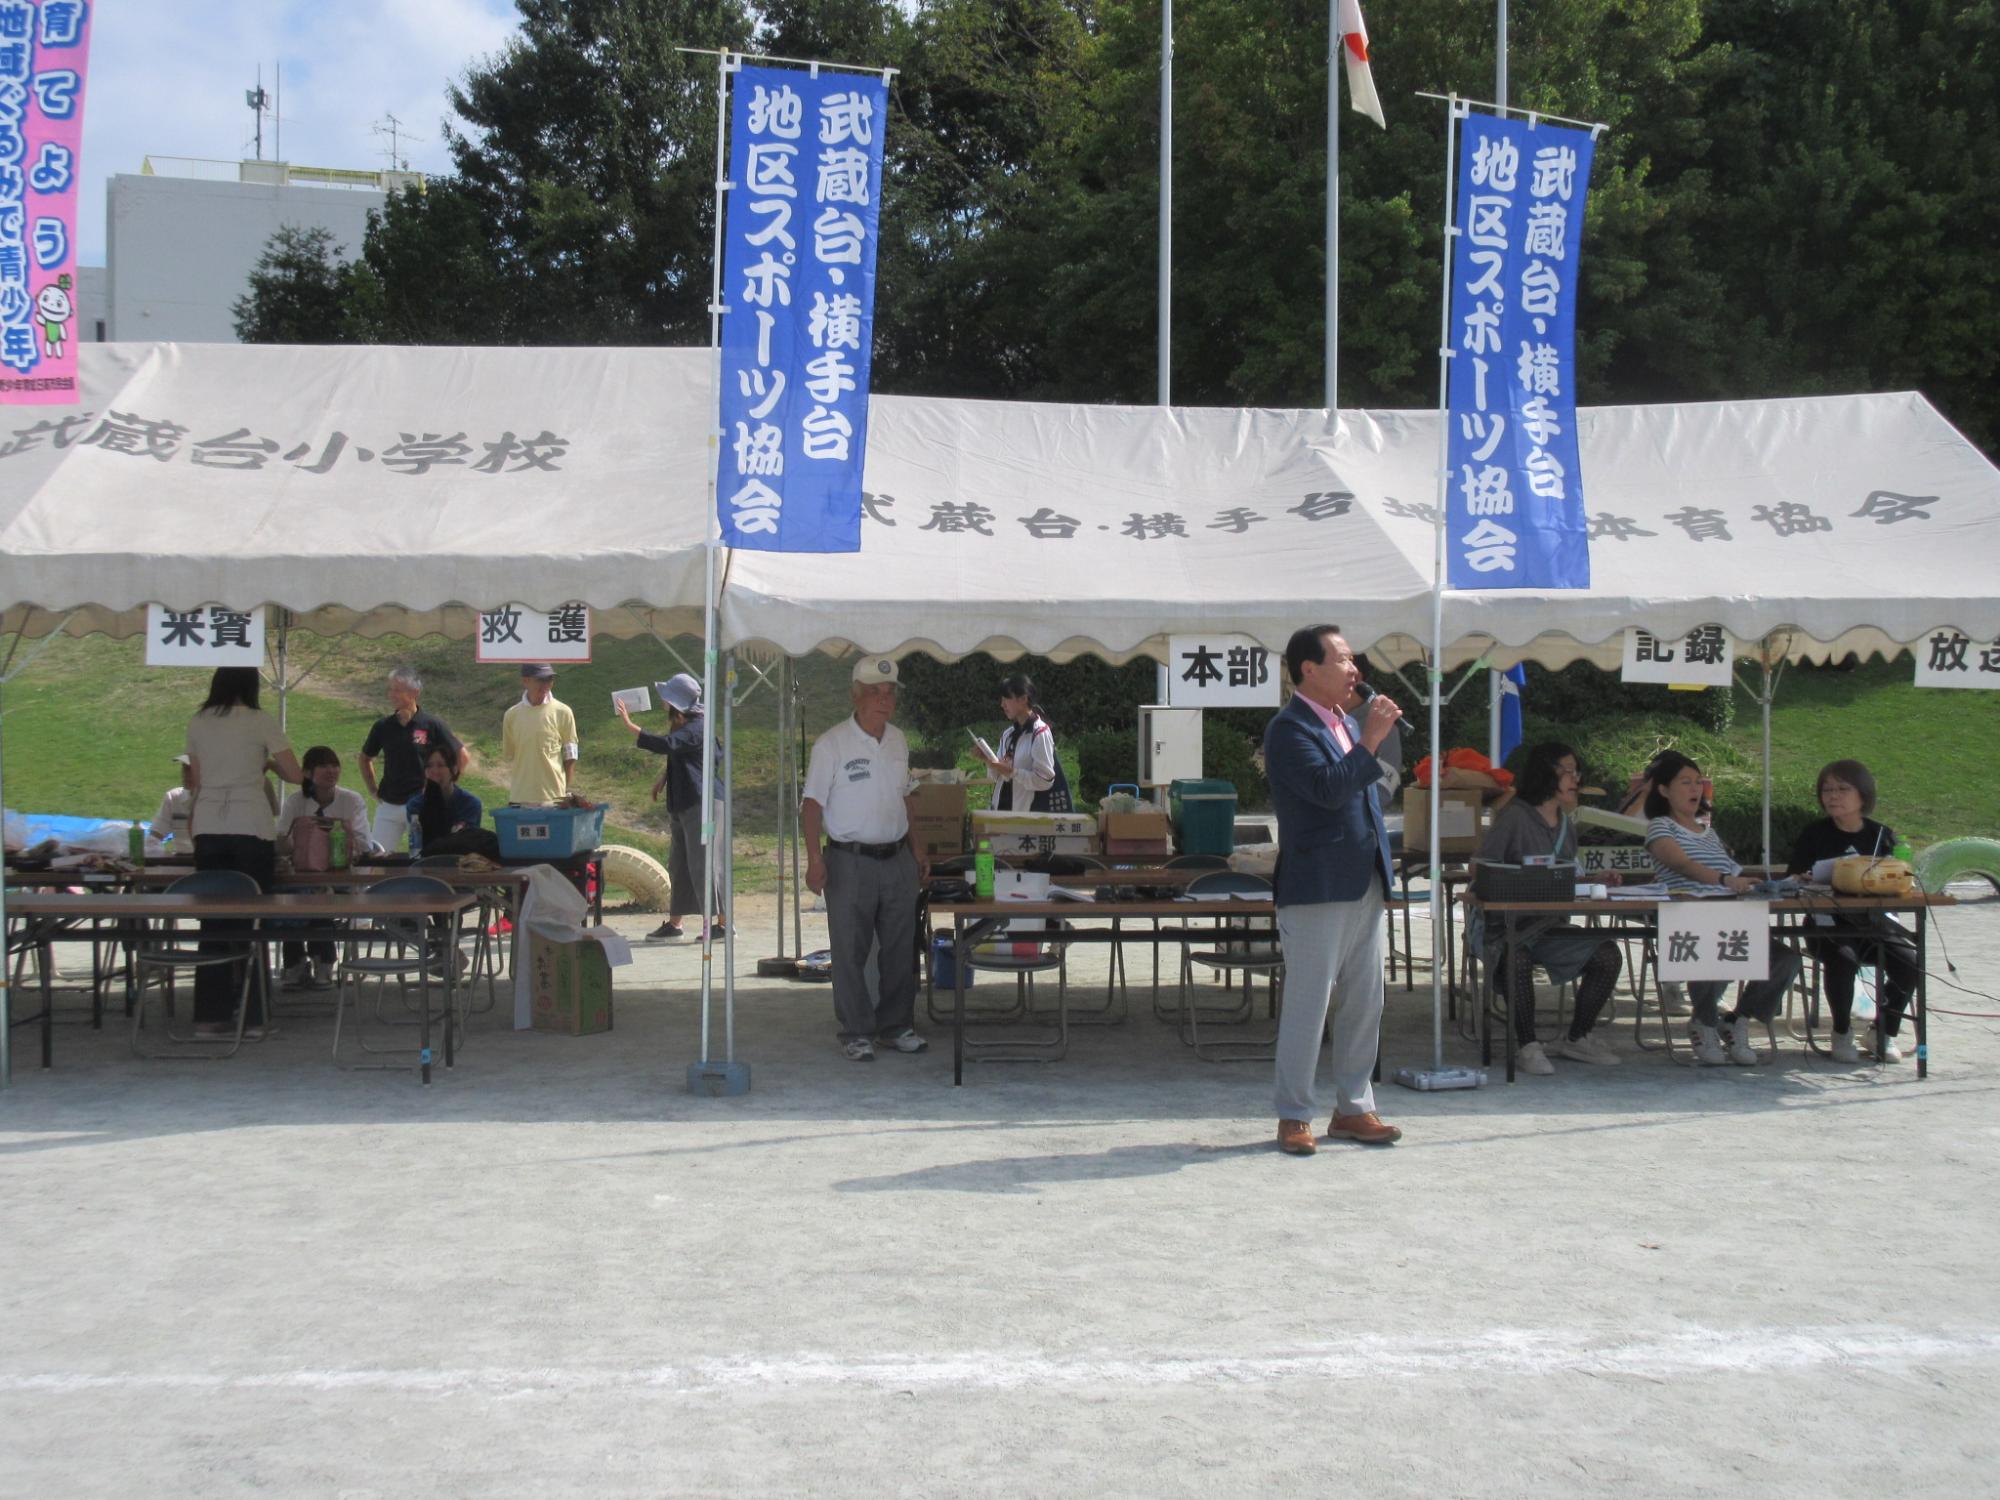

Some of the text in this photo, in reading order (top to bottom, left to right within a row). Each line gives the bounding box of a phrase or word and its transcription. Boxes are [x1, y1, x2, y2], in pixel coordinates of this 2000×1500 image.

[31, 0, 84, 268] 育てよう
[730, 85, 803, 536] 地区スポーツ協会
[1460, 135, 1520, 573] 地区スポーツ協会
[0, 409, 571, 475] 武蔵台小学校
[161, 607, 253, 648] 来賓
[481, 604, 587, 644] 救護
[1182, 645, 1270, 687] 本部
[1635, 626, 1716, 665] 記録
[1018, 834, 1056, 852] 本部
[1668, 930, 1750, 963] 放送
